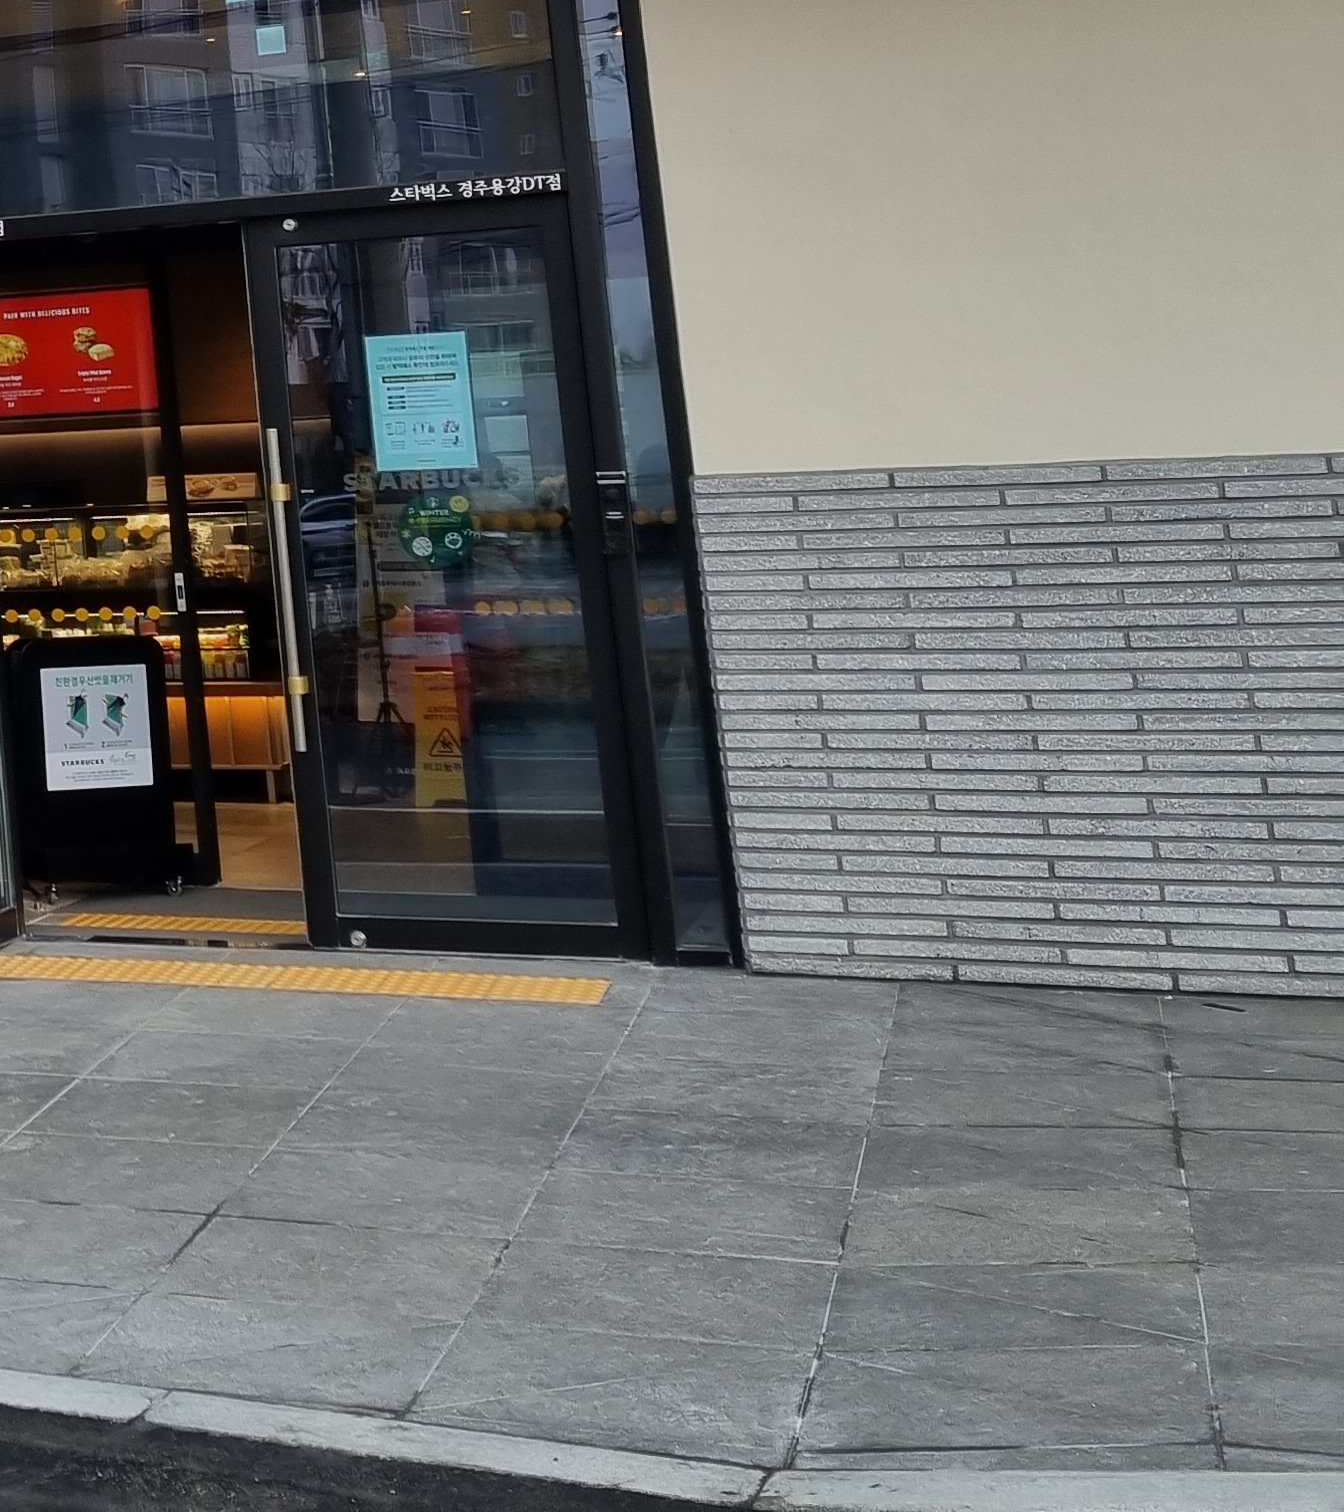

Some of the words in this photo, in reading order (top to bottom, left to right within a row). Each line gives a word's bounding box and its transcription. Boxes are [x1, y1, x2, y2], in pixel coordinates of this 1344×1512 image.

[389, 183, 453, 202] 스타벅스
[457, 173, 562, 198] 경주용강DT점
[61, 759, 105, 767] STARBUCKS
